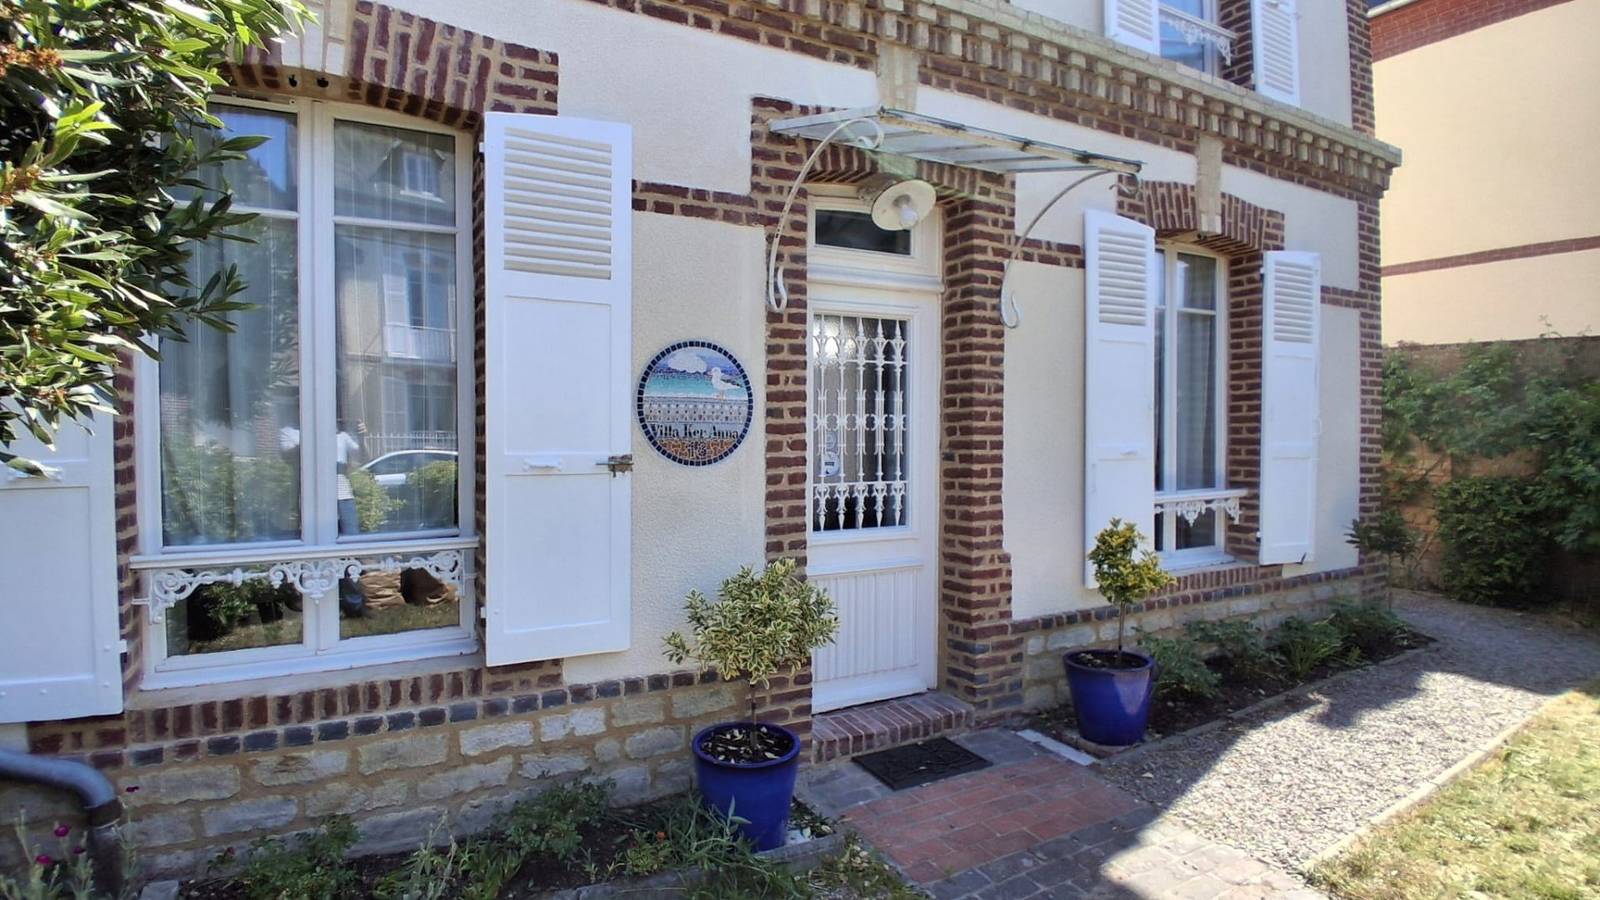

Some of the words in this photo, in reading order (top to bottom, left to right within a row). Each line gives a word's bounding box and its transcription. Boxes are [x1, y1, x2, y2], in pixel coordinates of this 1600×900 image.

[650, 423, 679, 438] Villa
[683, 424, 707, 439] Ker
[709, 425, 739, 439] Anna
